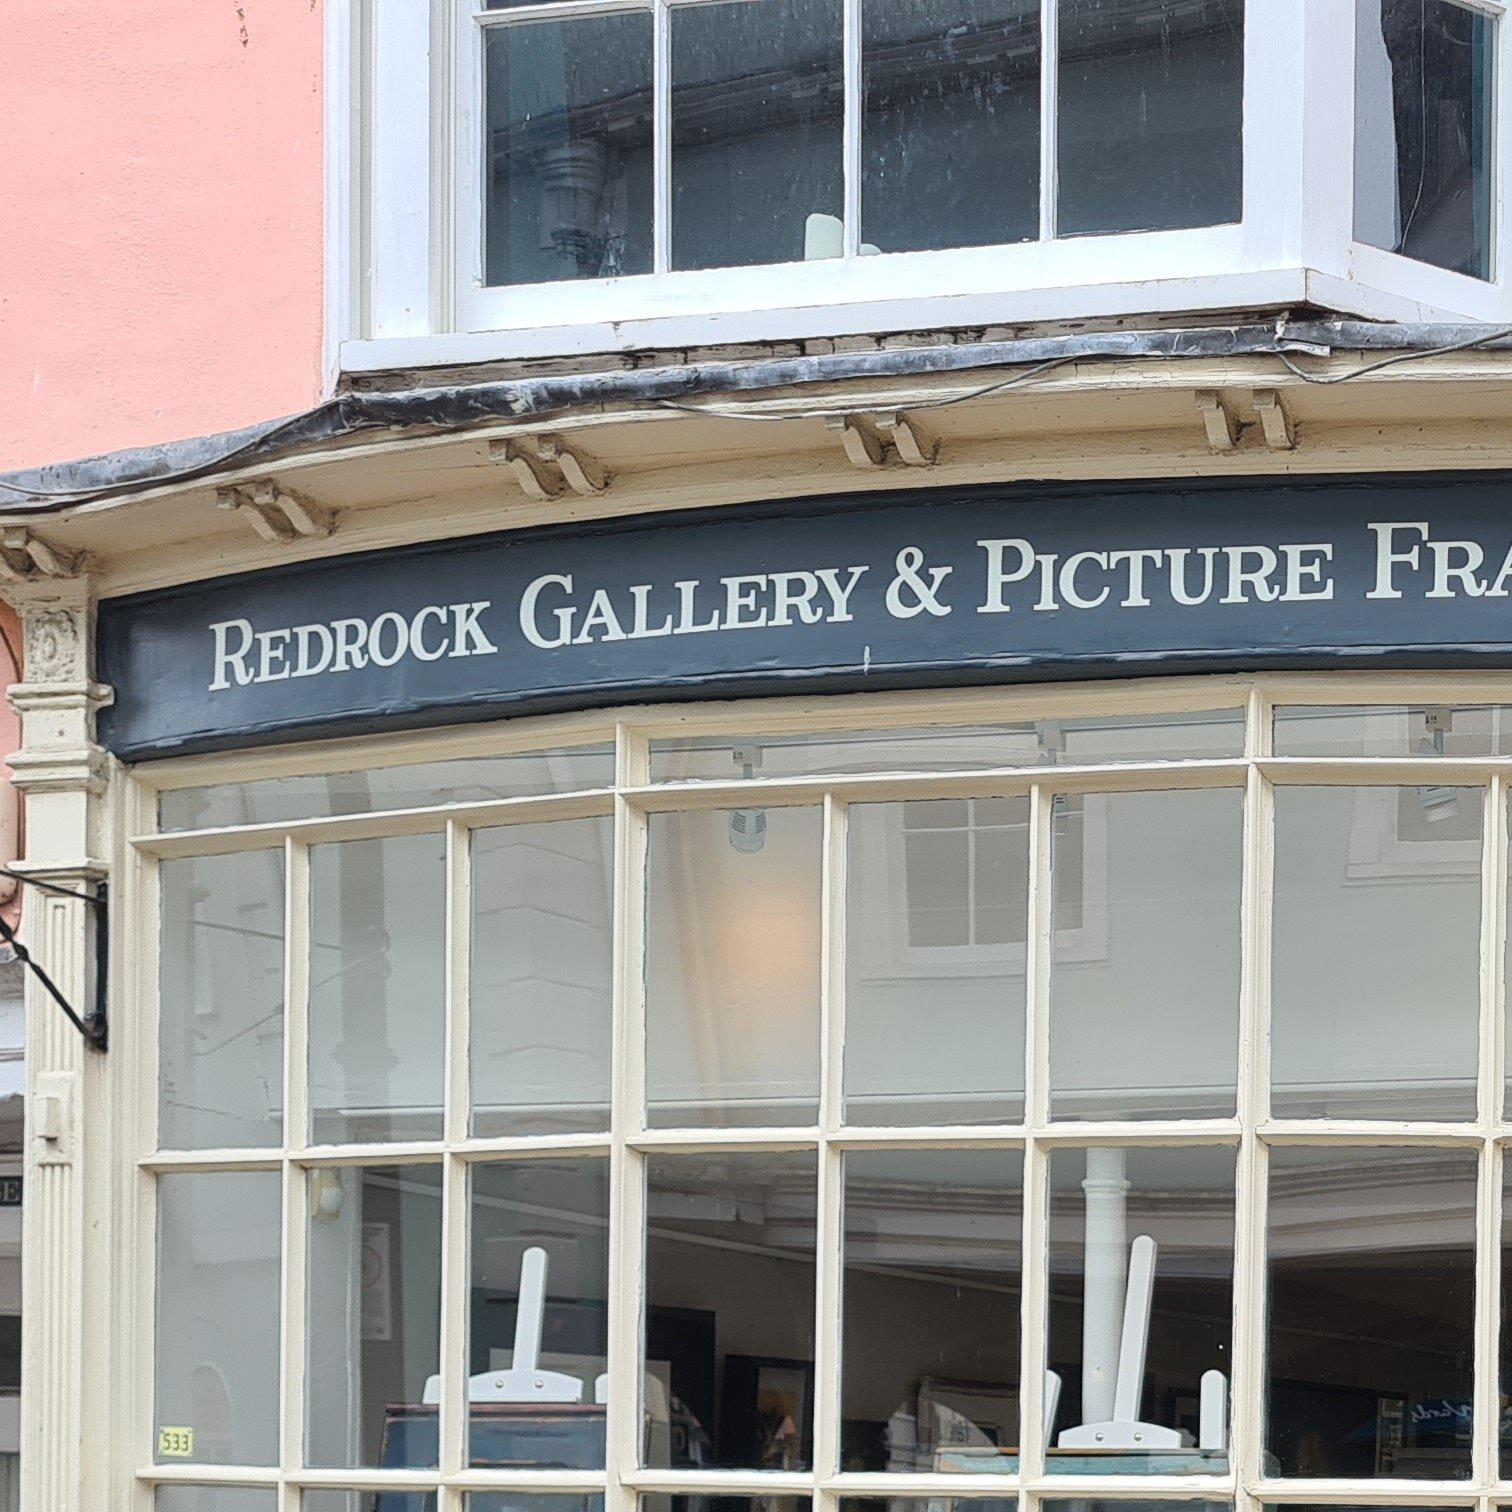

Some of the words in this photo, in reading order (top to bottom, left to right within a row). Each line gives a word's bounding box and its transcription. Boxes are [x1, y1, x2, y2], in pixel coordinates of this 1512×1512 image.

[207, 600, 499, 692] REDROCK
[519, 564, 871, 652] GALLERY
[885, 545, 953, 619] &
[976, 537, 1334, 615] PICTURE
[162, 1432, 189, 1452] 533
